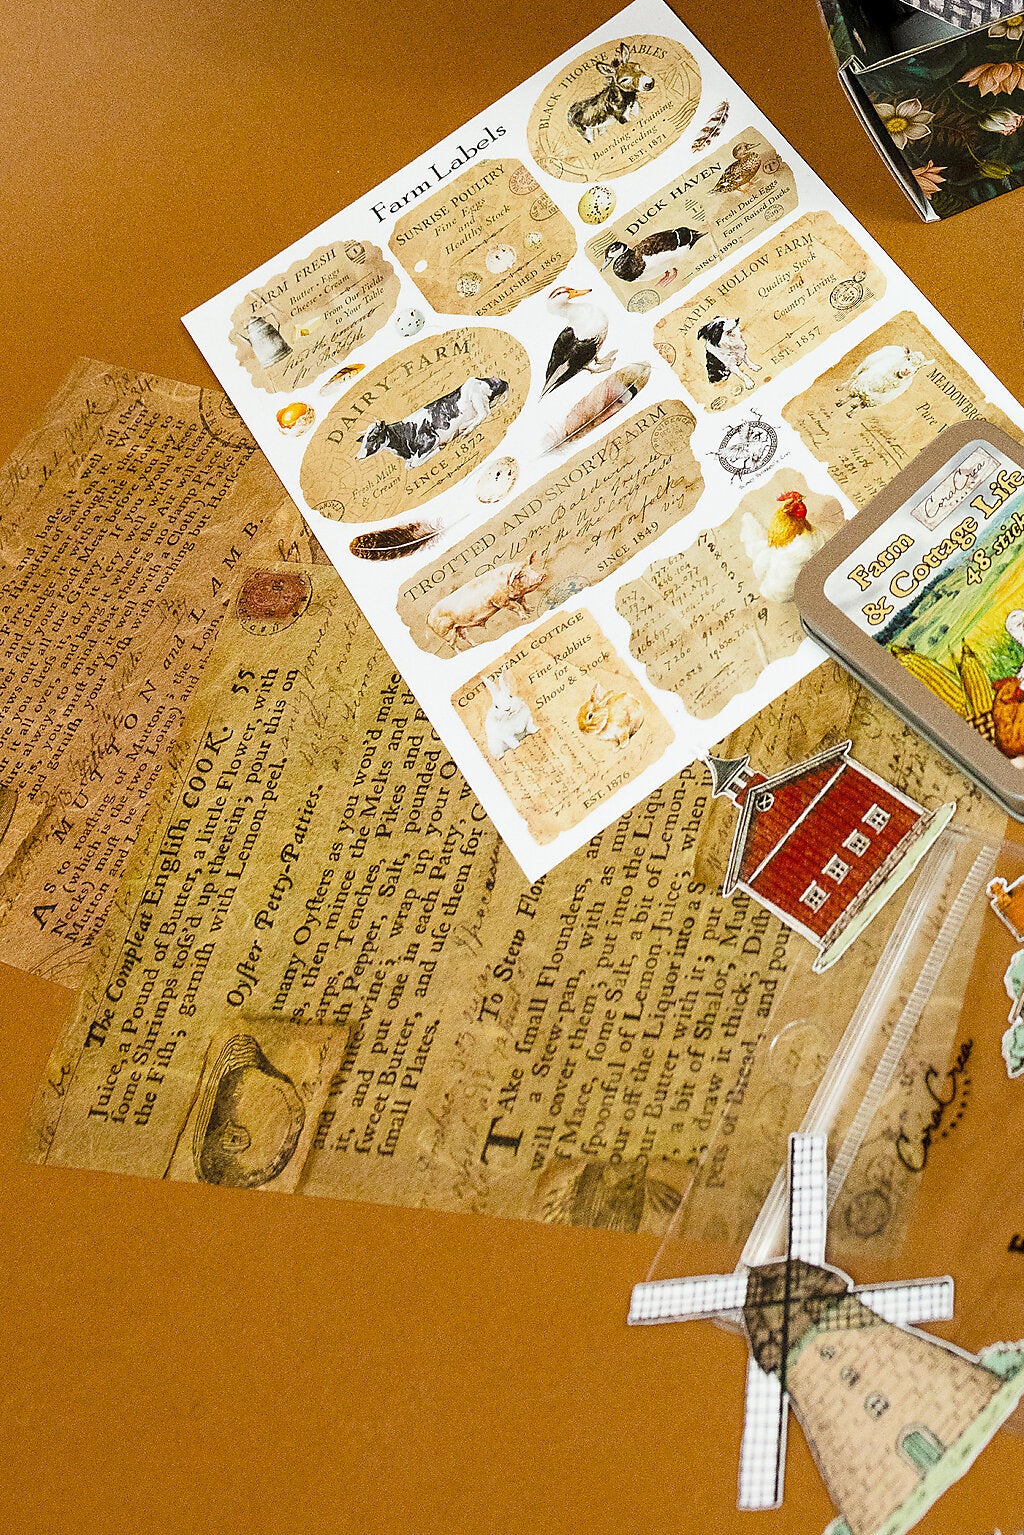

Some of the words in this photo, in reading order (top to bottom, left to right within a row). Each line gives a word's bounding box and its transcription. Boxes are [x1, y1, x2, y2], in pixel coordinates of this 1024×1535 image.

[534, 90, 572, 132] BLACK
[557, 50, 611, 90] THORNE
[590, 130, 632, 162] Boarding
[634, 99, 675, 129] Training
[618, 123, 659, 155] Breeding
[627, 146, 648, 164] EST.
[369, 177, 433, 224] Farm
[427, 122, 508, 182] Labels
[623, 198, 669, 237] DUCK
[668, 160, 723, 200] HAVEN
[714, 207, 738, 227] Fresh
[736, 192, 759, 212] Duck
[757, 178, 779, 197] Eggs
[394, 204, 451, 247] SUNRISE
[449, 163, 506, 208] POULTRY
[443, 223, 484, 256] Healthy
[483, 203, 512, 227] Stock
[721, 220, 744, 239] Farm
[742, 201, 769, 223] Raised
[766, 185, 791, 206] Ducks
[249, 279, 290, 314] FARM
[293, 247, 337, 283] FRESH
[287, 284, 315, 306] Butter
[319, 266, 341, 285] Eggs
[359, 273, 385, 294] Fields
[473, 268, 540, 317] ESTABLISHED
[539, 250, 563, 271] 1865
[675, 293, 719, 336] MAPLE
[716, 252, 771, 297] HOLLOW
[774, 230, 814, 260] FARM
[693, 252, 721, 273] SINCE
[717, 237, 739, 255] 1890
[755, 269, 792, 300] Quality
[791, 250, 818, 273] Stock
[288, 295, 318, 318] Cheese
[322, 273, 351, 295] Cream
[361, 286, 385, 305] Table
[771, 292, 807, 322] Country
[804, 272, 838, 298] Living
[794, 324, 822, 348] 1857
[321, 375, 396, 446] DAIRY
[399, 329, 472, 390] FARM
[914, 400, 940, 427] Pure
[403, 458, 450, 496] SINCE
[453, 431, 486, 460] 1872
[401, 531, 498, 603] TROTTED
[500, 497, 544, 537] AND
[542, 447, 609, 502] SNORT
[608, 403, 671, 456] FARM
[595, 542, 631, 573] SINCE
[630, 520, 660, 546] 1849
[847, 530, 915, 592] Farm
[862, 595, 894, 626] &
[888, 512, 979, 607] Cottage
[963, 547, 995, 588] 48
[526, 662, 553, 685] Fine
[549, 633, 593, 666] Rabbits
[529, 611, 585, 651] COTTAGE
[533, 682, 567, 711] Show
[578, 650, 610, 675] Stock
[225, 755, 289, 881] Lemon-peel.
[581, 788, 606, 810] EST.
[604, 770, 631, 792] 1876
[82, 1006, 116, 1050] The
[103, 905, 155, 1004] Compleat
[230, 667, 256, 695] 55
[252, 781, 324, 932] Petty-Patties.
[341, 912, 388, 993] Pepper,
[402, 749, 442, 835] pounded
[86, 1056, 129, 1124] Juice,
[120, 966, 160, 1036] Pound
[158, 865, 203, 936] Butter,
[214, 715, 263, 793] Flower,
[131, 976, 180, 1067] Shrimps
[206, 793, 254, 876] therein;
[333, 856, 386, 951] Tenches,
[535, 875, 593, 990] Flounders,
[491, 926, 526, 983] Stew
[399, 1017, 441, 1091] Plates.
